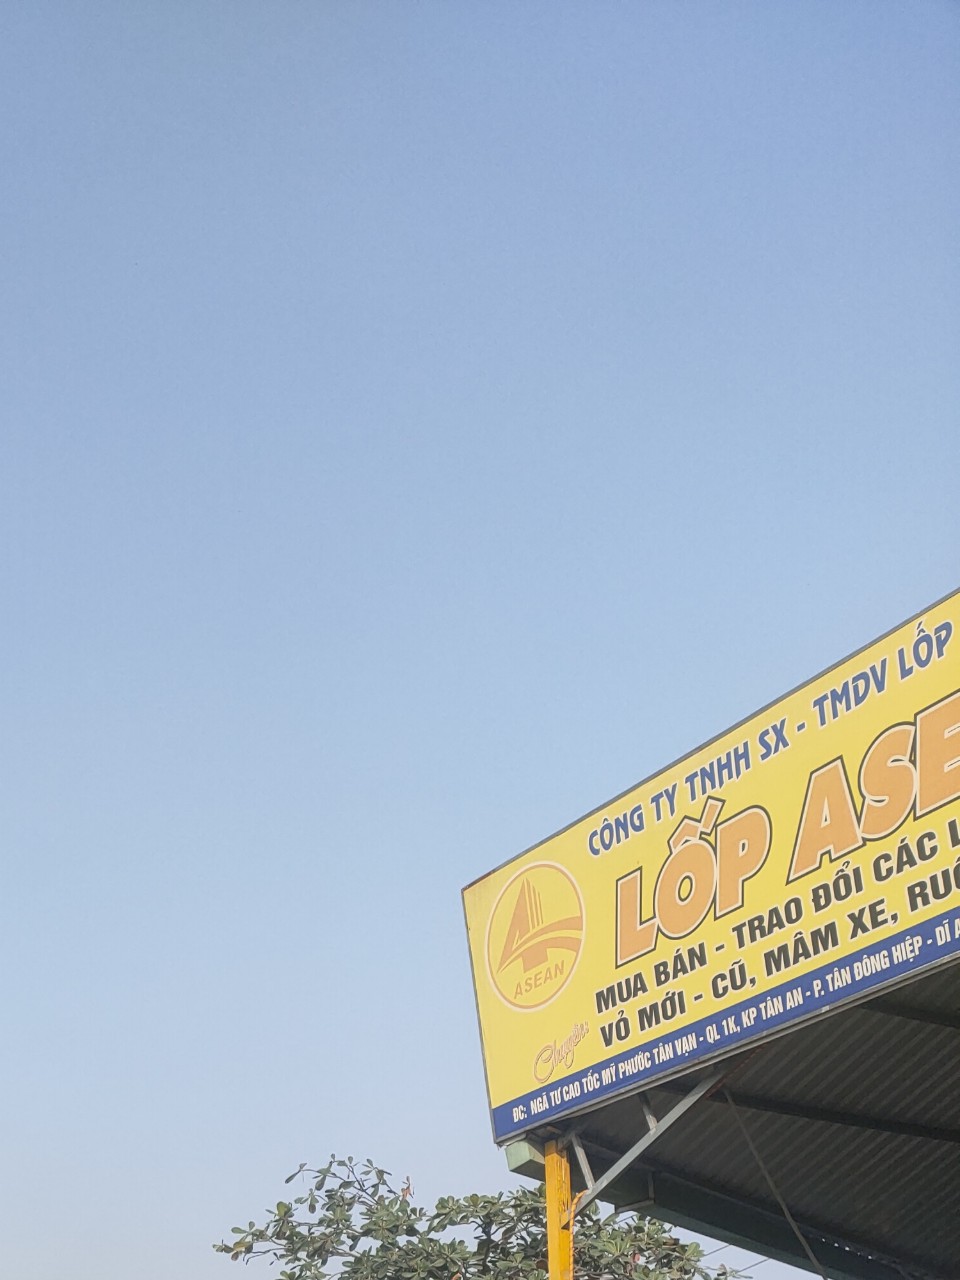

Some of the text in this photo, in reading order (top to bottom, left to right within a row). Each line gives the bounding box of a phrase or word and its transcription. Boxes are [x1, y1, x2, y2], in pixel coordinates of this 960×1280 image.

[589, 804, 645, 856] CÔNG
[650, 783, 678, 823] TY
[684, 740, 751, 802] TNHH
[758, 718, 790, 761] SX
[812, 657, 887, 727] TMDV
[897, 620, 953, 681] LỐP
[595, 972, 648, 1014] MUA
[654, 942, 707, 987] BÁN
[732, 897, 803, 949] TRAO
[811, 860, 863, 913] ĐỔI
[873, 831, 938, 882] CÁC
[615, 796, 772, 968] LỐP
[512, 1105, 527, 1122] ĐC:
[530, 1096, 549, 1115] NGÃ
[550, 1091, 562, 1107] TƯ
[562, 1083, 581, 1102] CAO
[582, 1070, 600, 1094] TỐC
[601, 1064, 616, 1086] MỸ
[618, 1050, 652, 1079] PHƯỚC
[652, 1045, 674, 1065] TÂN
[674, 1032, 698, 1057] VẠN
[705, 1025, 721, 1043] QL
[721, 1015, 741, 1037] 1K,
[741, 1006, 757, 1028] KP
[759, 995, 784, 1020] TÂN
[786, 986, 803, 1011] AN
[813, 979, 825, 998] P.
[825, 967, 852, 992] TÂN
[853, 949, 890, 981] ĐÔNG
[891, 934, 923, 965] HIỆP
[934, 920, 951, 947] DĨ
[514, 960, 565, 1000] ASEAN
[600, 1010, 630, 1047] VỎ
[638, 990, 686, 1031] MỚI
[712, 960, 756, 999] CŨ,
[764, 921, 839, 977] MÂM
[847, 898, 898, 940] XE,
